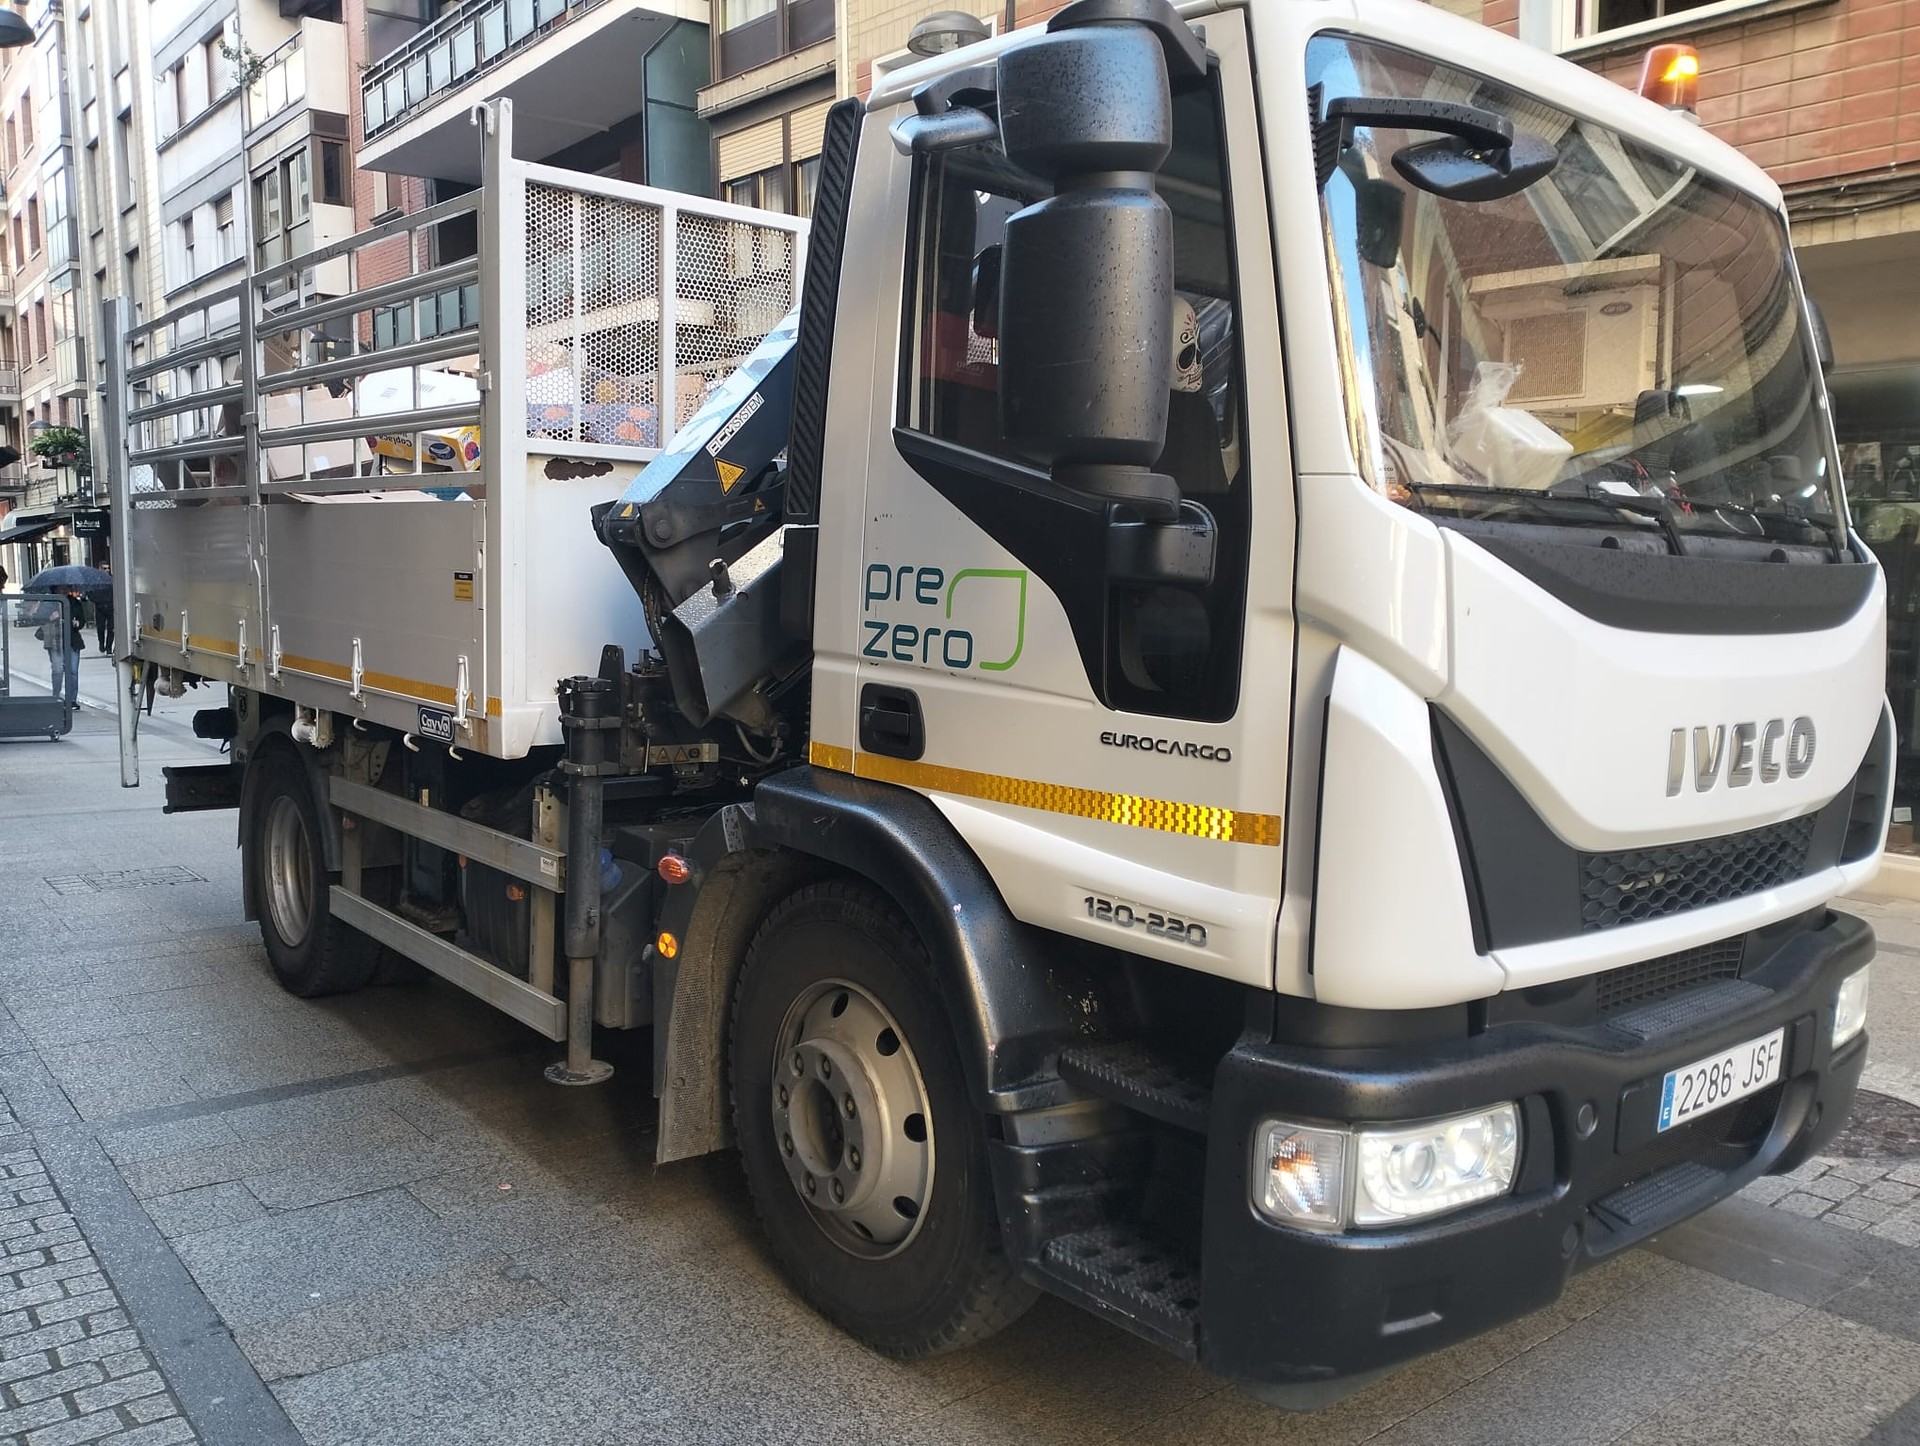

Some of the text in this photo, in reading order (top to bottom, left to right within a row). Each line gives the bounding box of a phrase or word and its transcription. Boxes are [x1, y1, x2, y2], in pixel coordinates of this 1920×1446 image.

[865, 564, 944, 611] pre
[863, 621, 973, 668] zero
[1100, 731, 1231, 762] EUROCARGO
[1666, 716, 1816, 797] IVECO
[1084, 896, 1207, 947] 120-220
[1678, 1058, 1733, 1116] 2286
[1742, 1039, 1778, 1088] JSF
